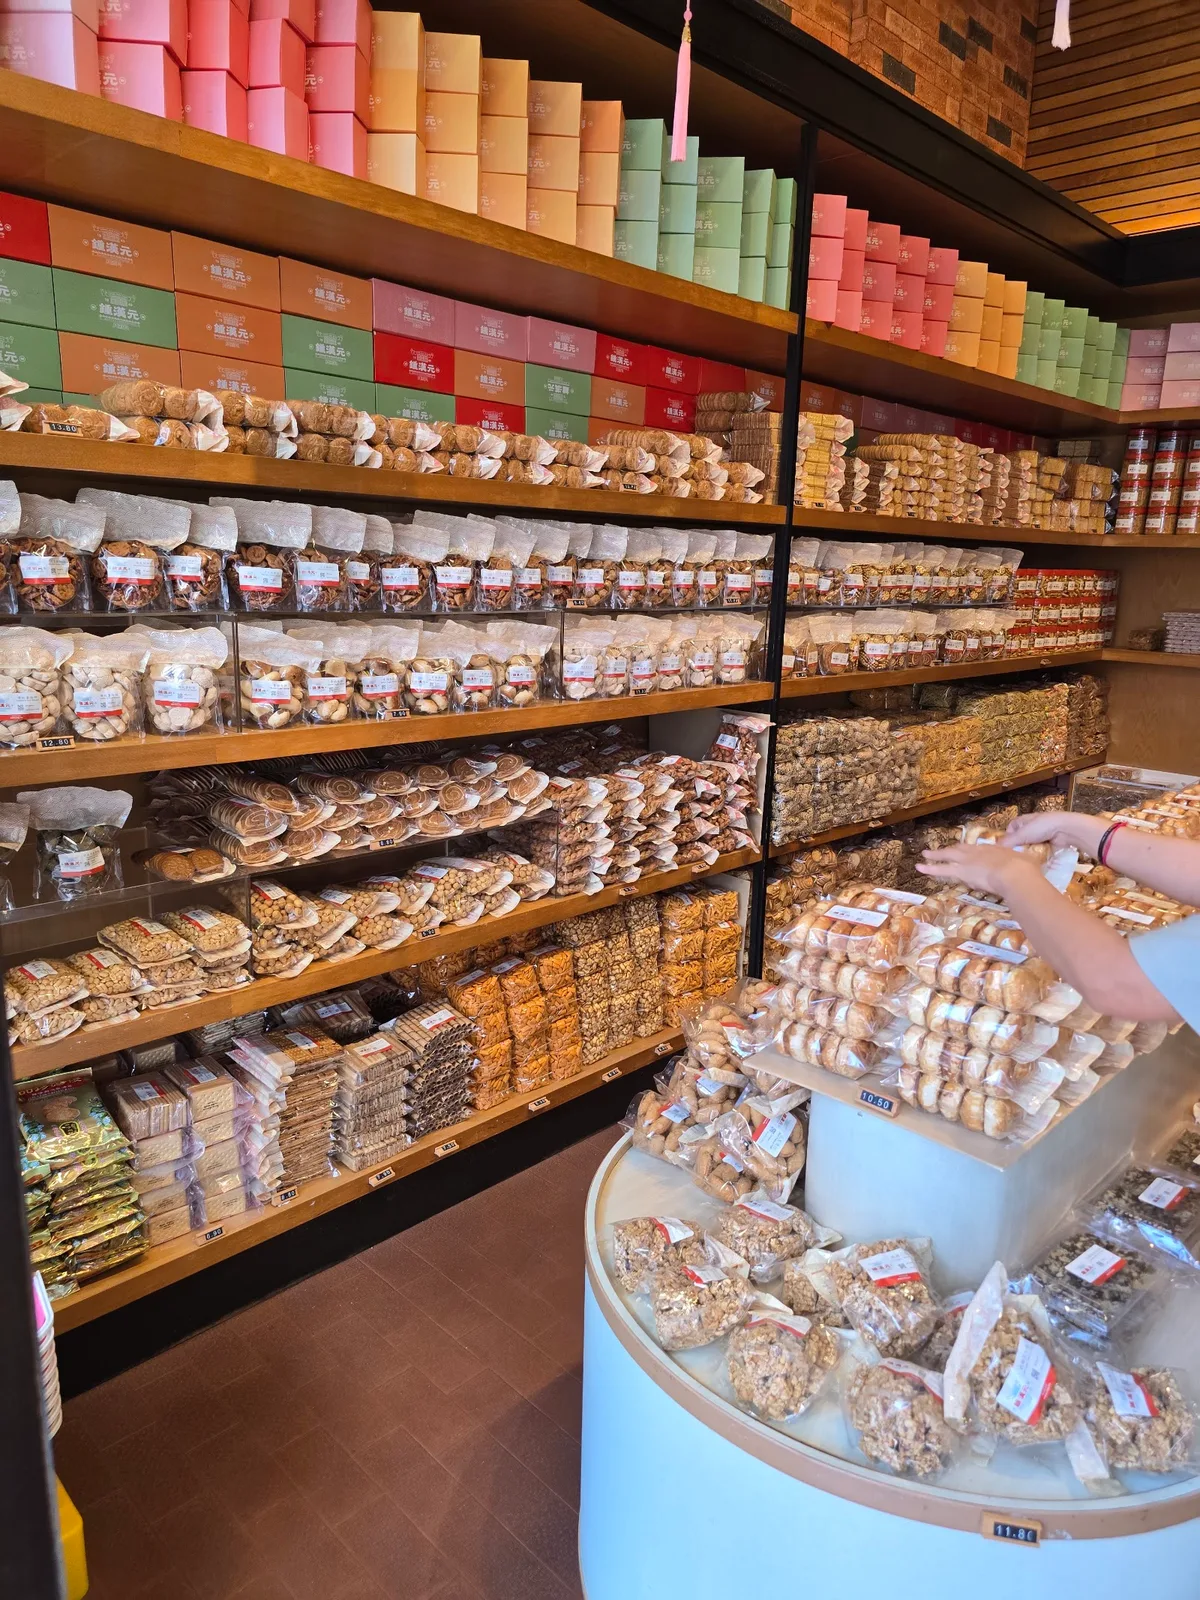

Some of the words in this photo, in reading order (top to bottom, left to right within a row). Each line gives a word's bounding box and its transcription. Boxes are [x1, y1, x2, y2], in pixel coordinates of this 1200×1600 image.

[52, 423, 77, 433] 13.80
[43, 738, 69, 747] 12.80
[862, 1092, 889, 1109] 10.50
